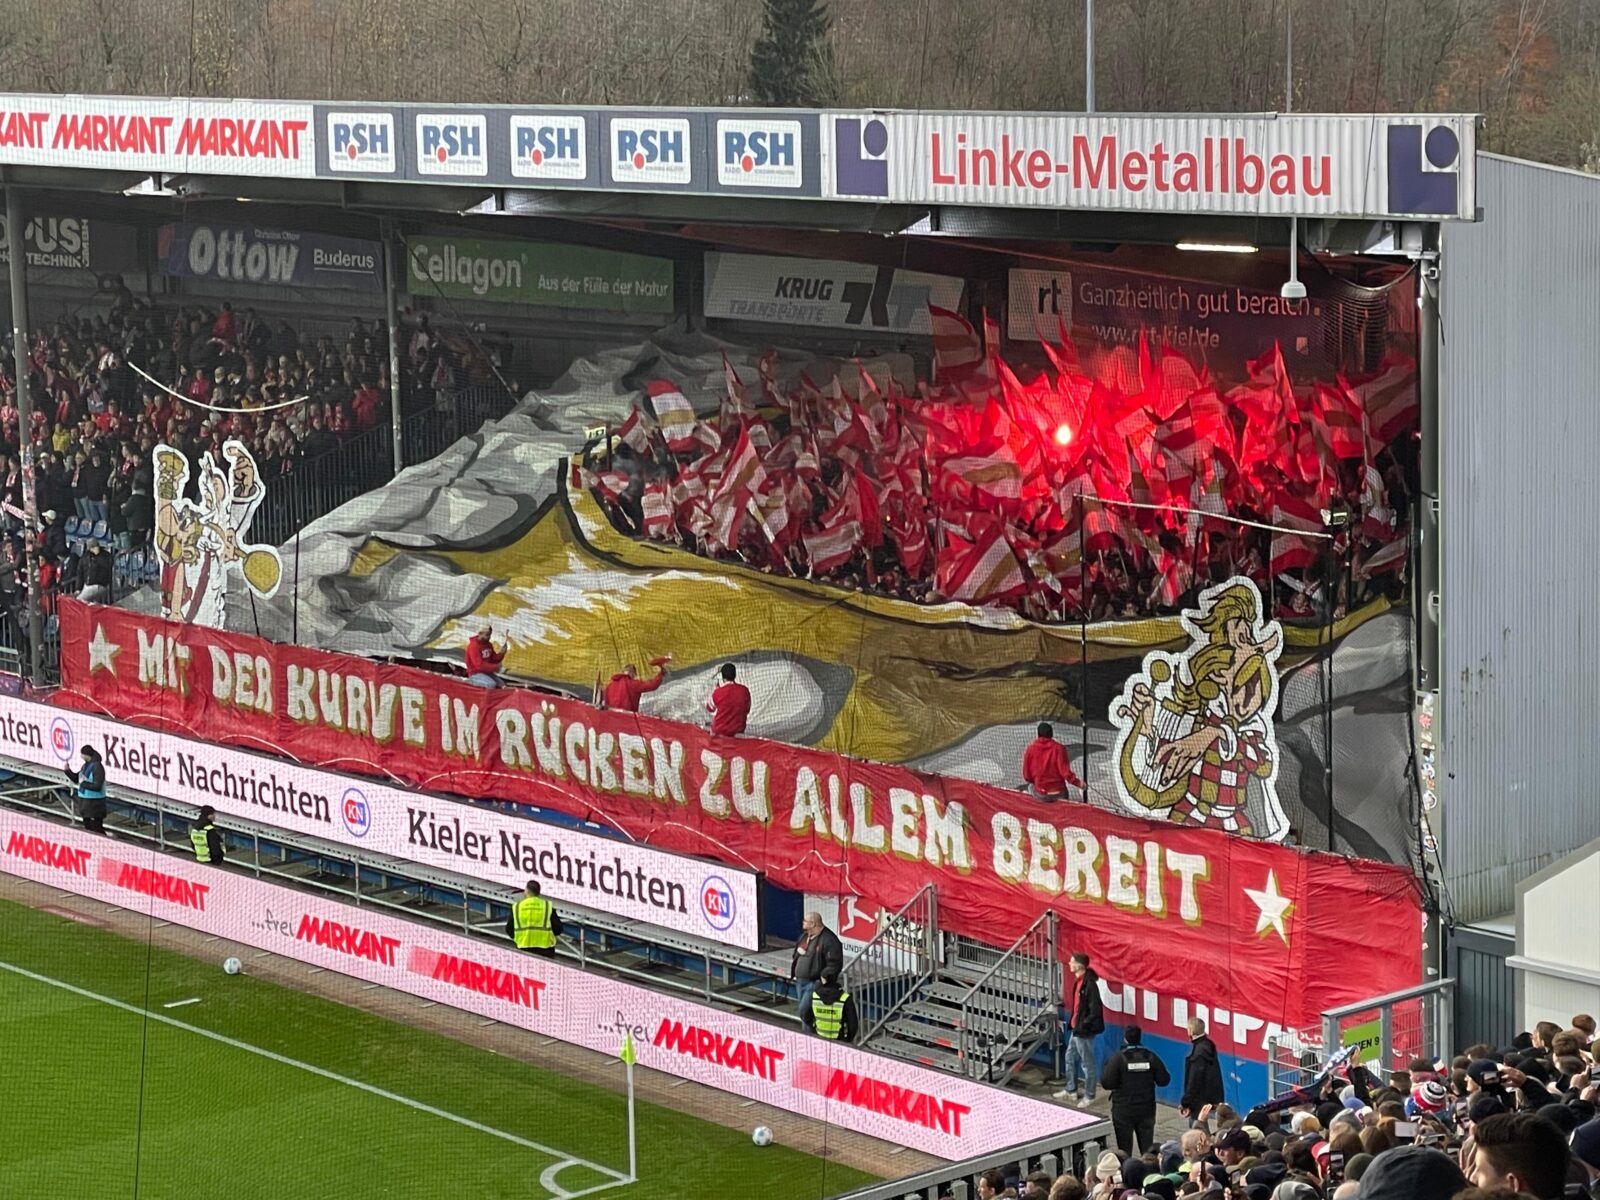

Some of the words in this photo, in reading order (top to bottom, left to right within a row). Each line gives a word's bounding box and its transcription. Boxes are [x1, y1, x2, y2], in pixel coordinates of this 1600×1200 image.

[51, 113, 174, 155] MARKANT
[174, 118, 309, 160] MARKANT
[334, 123, 389, 154] RSH
[422, 125, 481, 157] RSH
[517, 126, 579, 159] RSH
[617, 130, 683, 163] RSH
[725, 131, 794, 166] RSH
[931, 132, 1332, 197] Linke-Metallbau
[188, 226, 299, 281] Ottow
[313, 248, 375, 268] Buderus
[538, 274, 558, 290] Aus
[613, 278, 631, 295] der
[635, 280, 669, 297] Natur
[775, 276, 834, 301] KRUG
[1038, 278, 1062, 315] rt
[1079, 281, 1190, 312] Ganzheitlich
[1197, 289, 1230, 318] gut
[729, 300, 826, 323] TRANSPORTE
[103, 732, 173, 782] Kieler
[177, 751, 332, 824] Nachrichten
[208, 644, 273, 714] DER
[286, 664, 426, 745] KURVE
[438, 693, 481, 761] IM
[496, 700, 687, 804] RÜCKEN
[700, 748, 773, 823] ZU
[789, 765, 972, 873] ALLEM
[991, 811, 1209, 924] BEREIT
[6, 830, 92, 877] MARKANT
[407, 807, 492, 862] Kieler
[499, 829, 688, 914] Nachrichten
[118, 862, 210, 912] MARKANT
[705, 889, 730, 917] KN
[296, 914, 401, 967] MARKANT
[432, 952, 547, 1011] MARKANT
[653, 1017, 785, 1083] MARKANT
[1374, 1035, 1380, 1046] 9
[824, 1068, 971, 1138] MARKANT
